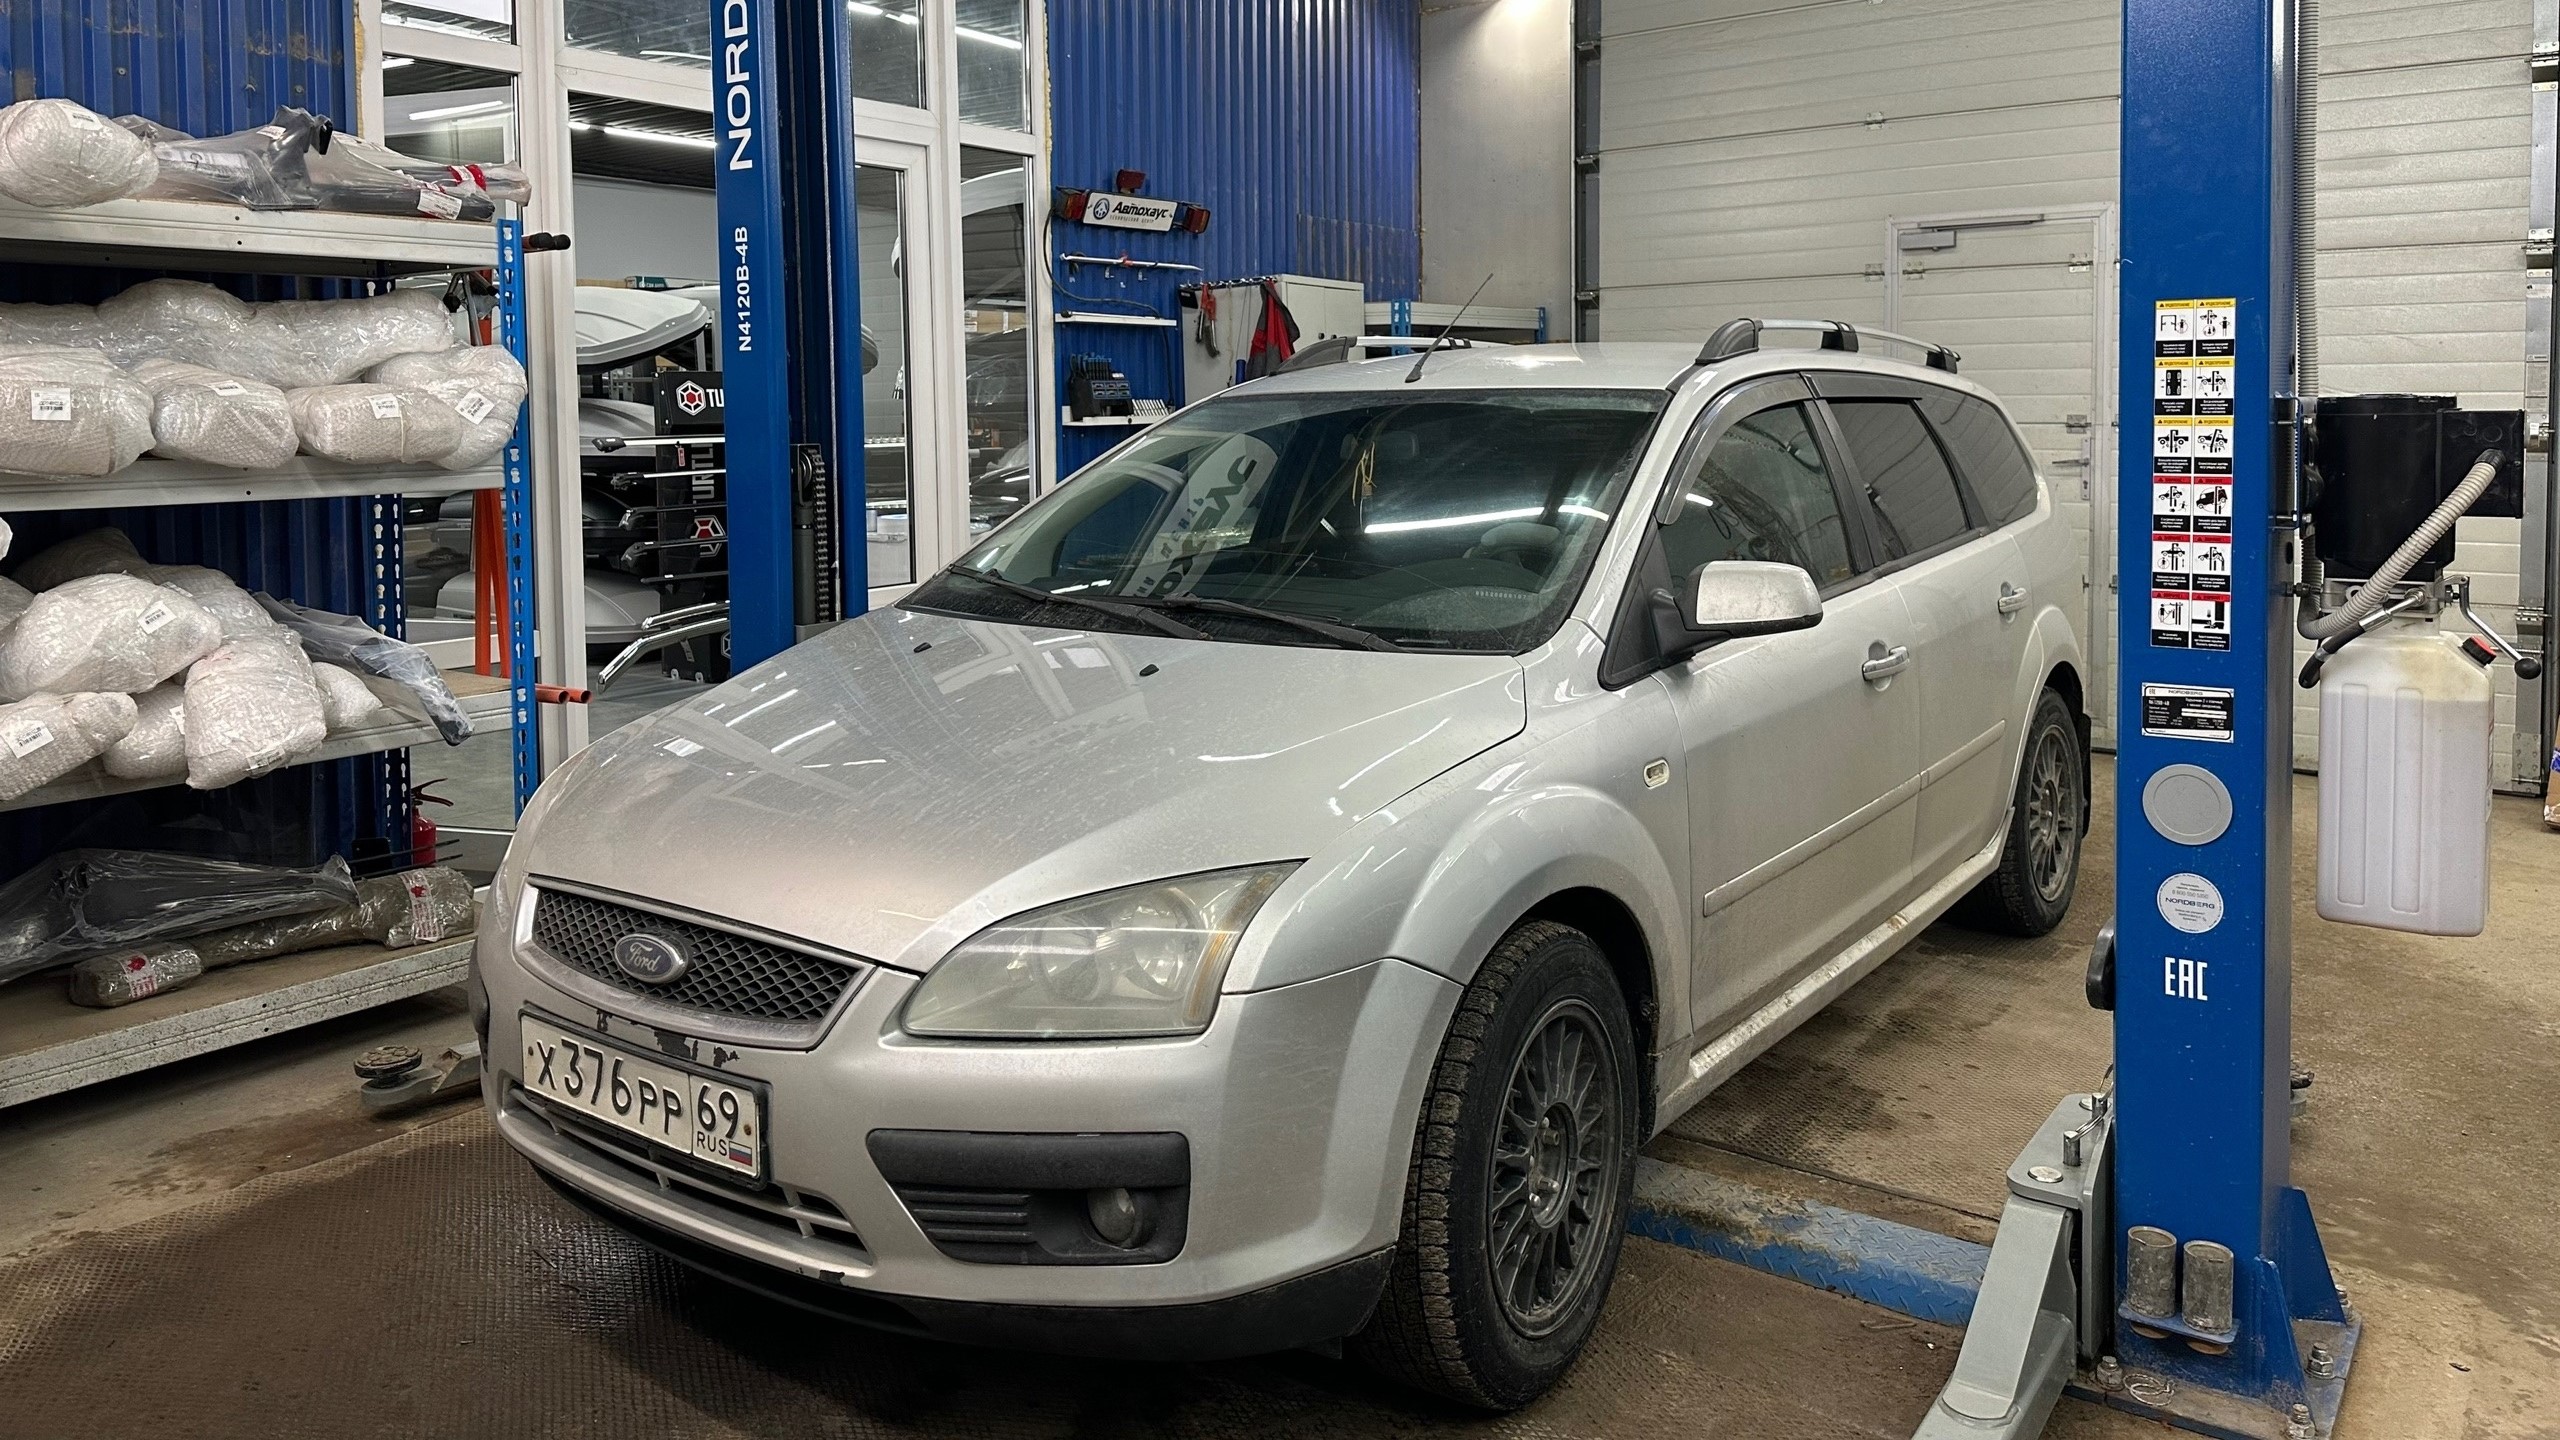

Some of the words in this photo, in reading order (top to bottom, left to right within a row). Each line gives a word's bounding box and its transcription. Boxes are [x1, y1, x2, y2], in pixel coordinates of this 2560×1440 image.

[724, 0, 752, 171] NORD
[1112, 201, 1169, 220] Автохаус
[735, 226, 751, 352] N4120B-4B
[691, 443, 714, 513] URTL
[2165, 897, 2215, 910] NORDBERG
[625, 942, 661, 972] Ford
[2165, 956, 2208, 1001] EAC
[697, 1082, 739, 1138] 69
[696, 1130, 729, 1157] RUS
